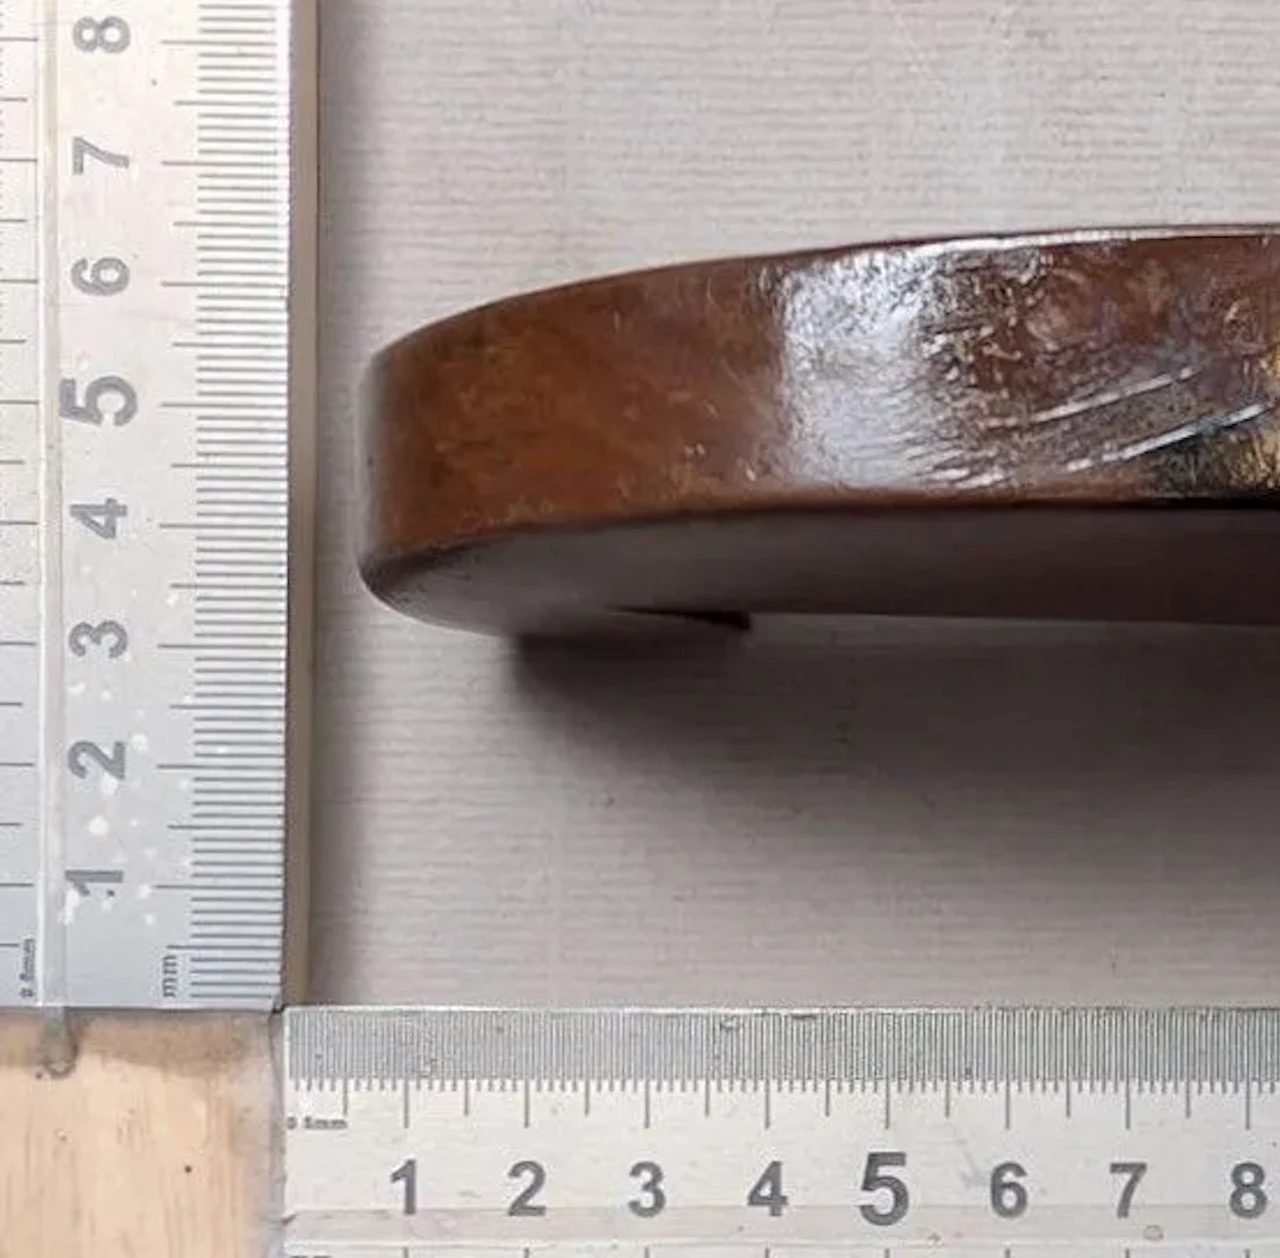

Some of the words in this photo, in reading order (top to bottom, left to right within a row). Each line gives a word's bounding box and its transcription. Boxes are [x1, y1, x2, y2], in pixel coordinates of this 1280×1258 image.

[72, 15, 131, 54] 8
[72, 136, 131, 176] 7
[70, 257, 130, 297] 6
[57, 375, 139, 427] 5
[69, 497, 129, 540] 4
[68, 619, 129, 659] 3
[66, 740, 127, 781] 2
[64, 868, 125, 897] 1
[161, 954, 179, 998] mm
[389, 1158, 419, 1217] 1
[505, 1160, 549, 1218] 2
[626, 1160, 667, 1219] 3
[746, 1160, 790, 1218] 4
[855, 1151, 910, 1227] 5
[989, 1160, 1029, 1220] 6
[1109, 1161, 1148, 1220] 7
[1228, 1160, 1269, 1221] 8
